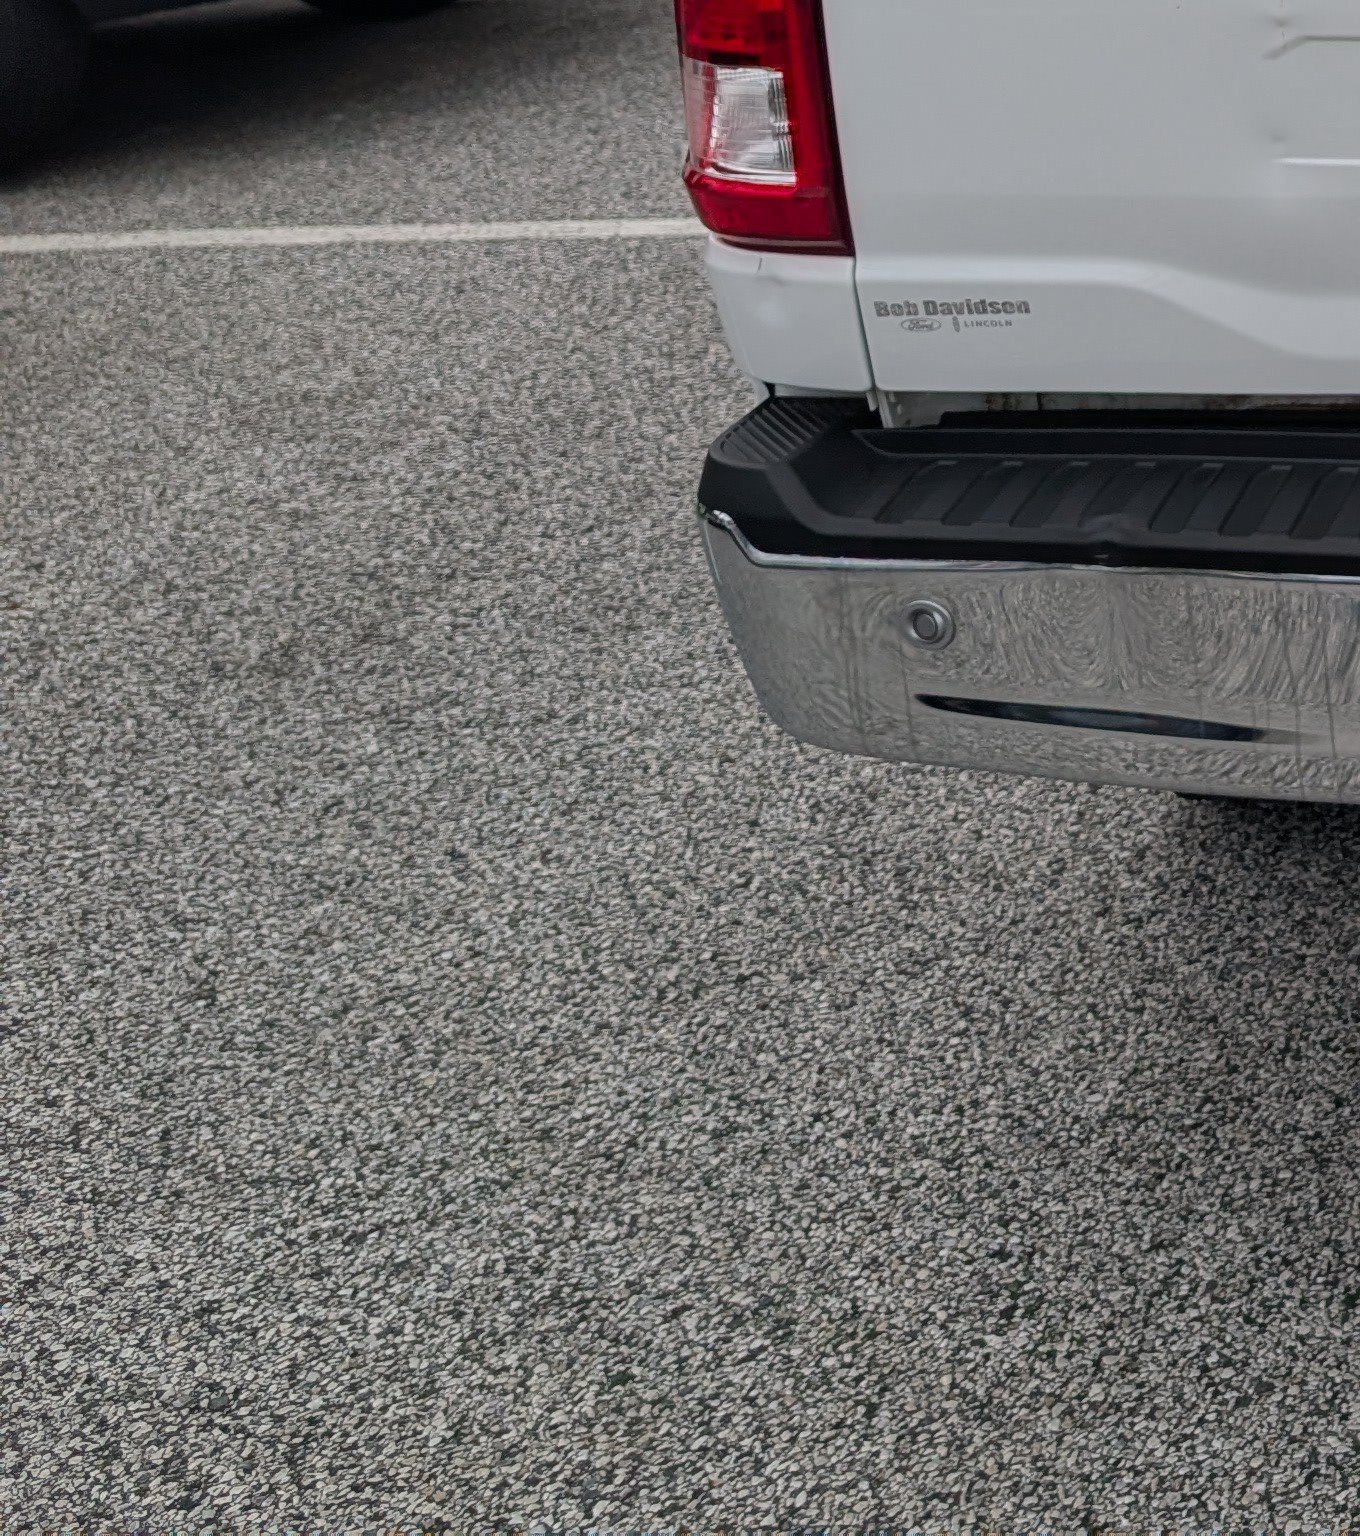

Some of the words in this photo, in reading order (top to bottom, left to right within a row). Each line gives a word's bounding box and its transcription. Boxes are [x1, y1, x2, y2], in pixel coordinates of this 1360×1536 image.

[873, 299, 919, 317] Bob
[922, 298, 1032, 316] Davidson
[964, 319, 1013, 328] LINCOLN
